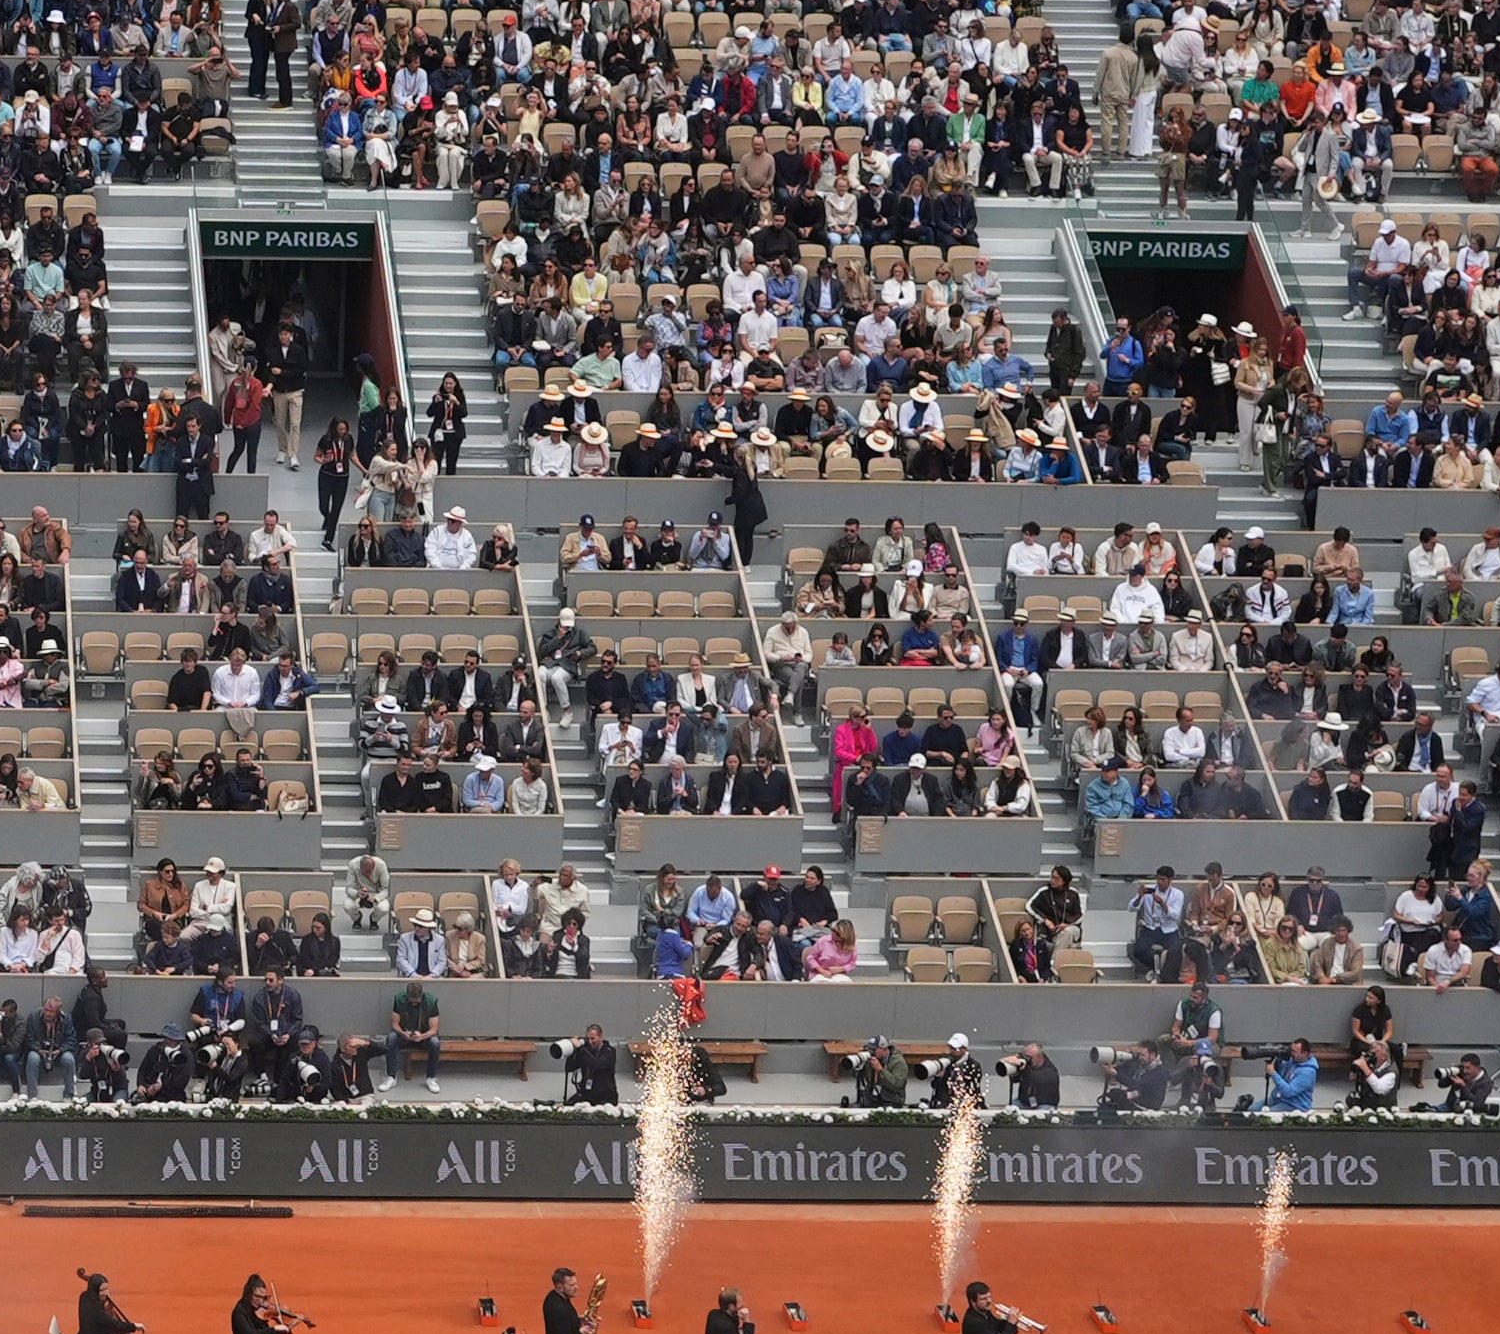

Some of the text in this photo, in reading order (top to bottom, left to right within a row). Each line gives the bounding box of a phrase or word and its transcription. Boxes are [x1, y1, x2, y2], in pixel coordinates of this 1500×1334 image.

[213, 229, 359, 248] BNP PARIBAS
[1089, 240, 1230, 259] BNP PARIBAS
[722, 1142, 907, 1184] Emirates
[960, 1146, 1144, 1185] mirates
[1195, 1147, 1378, 1186] Emiates
